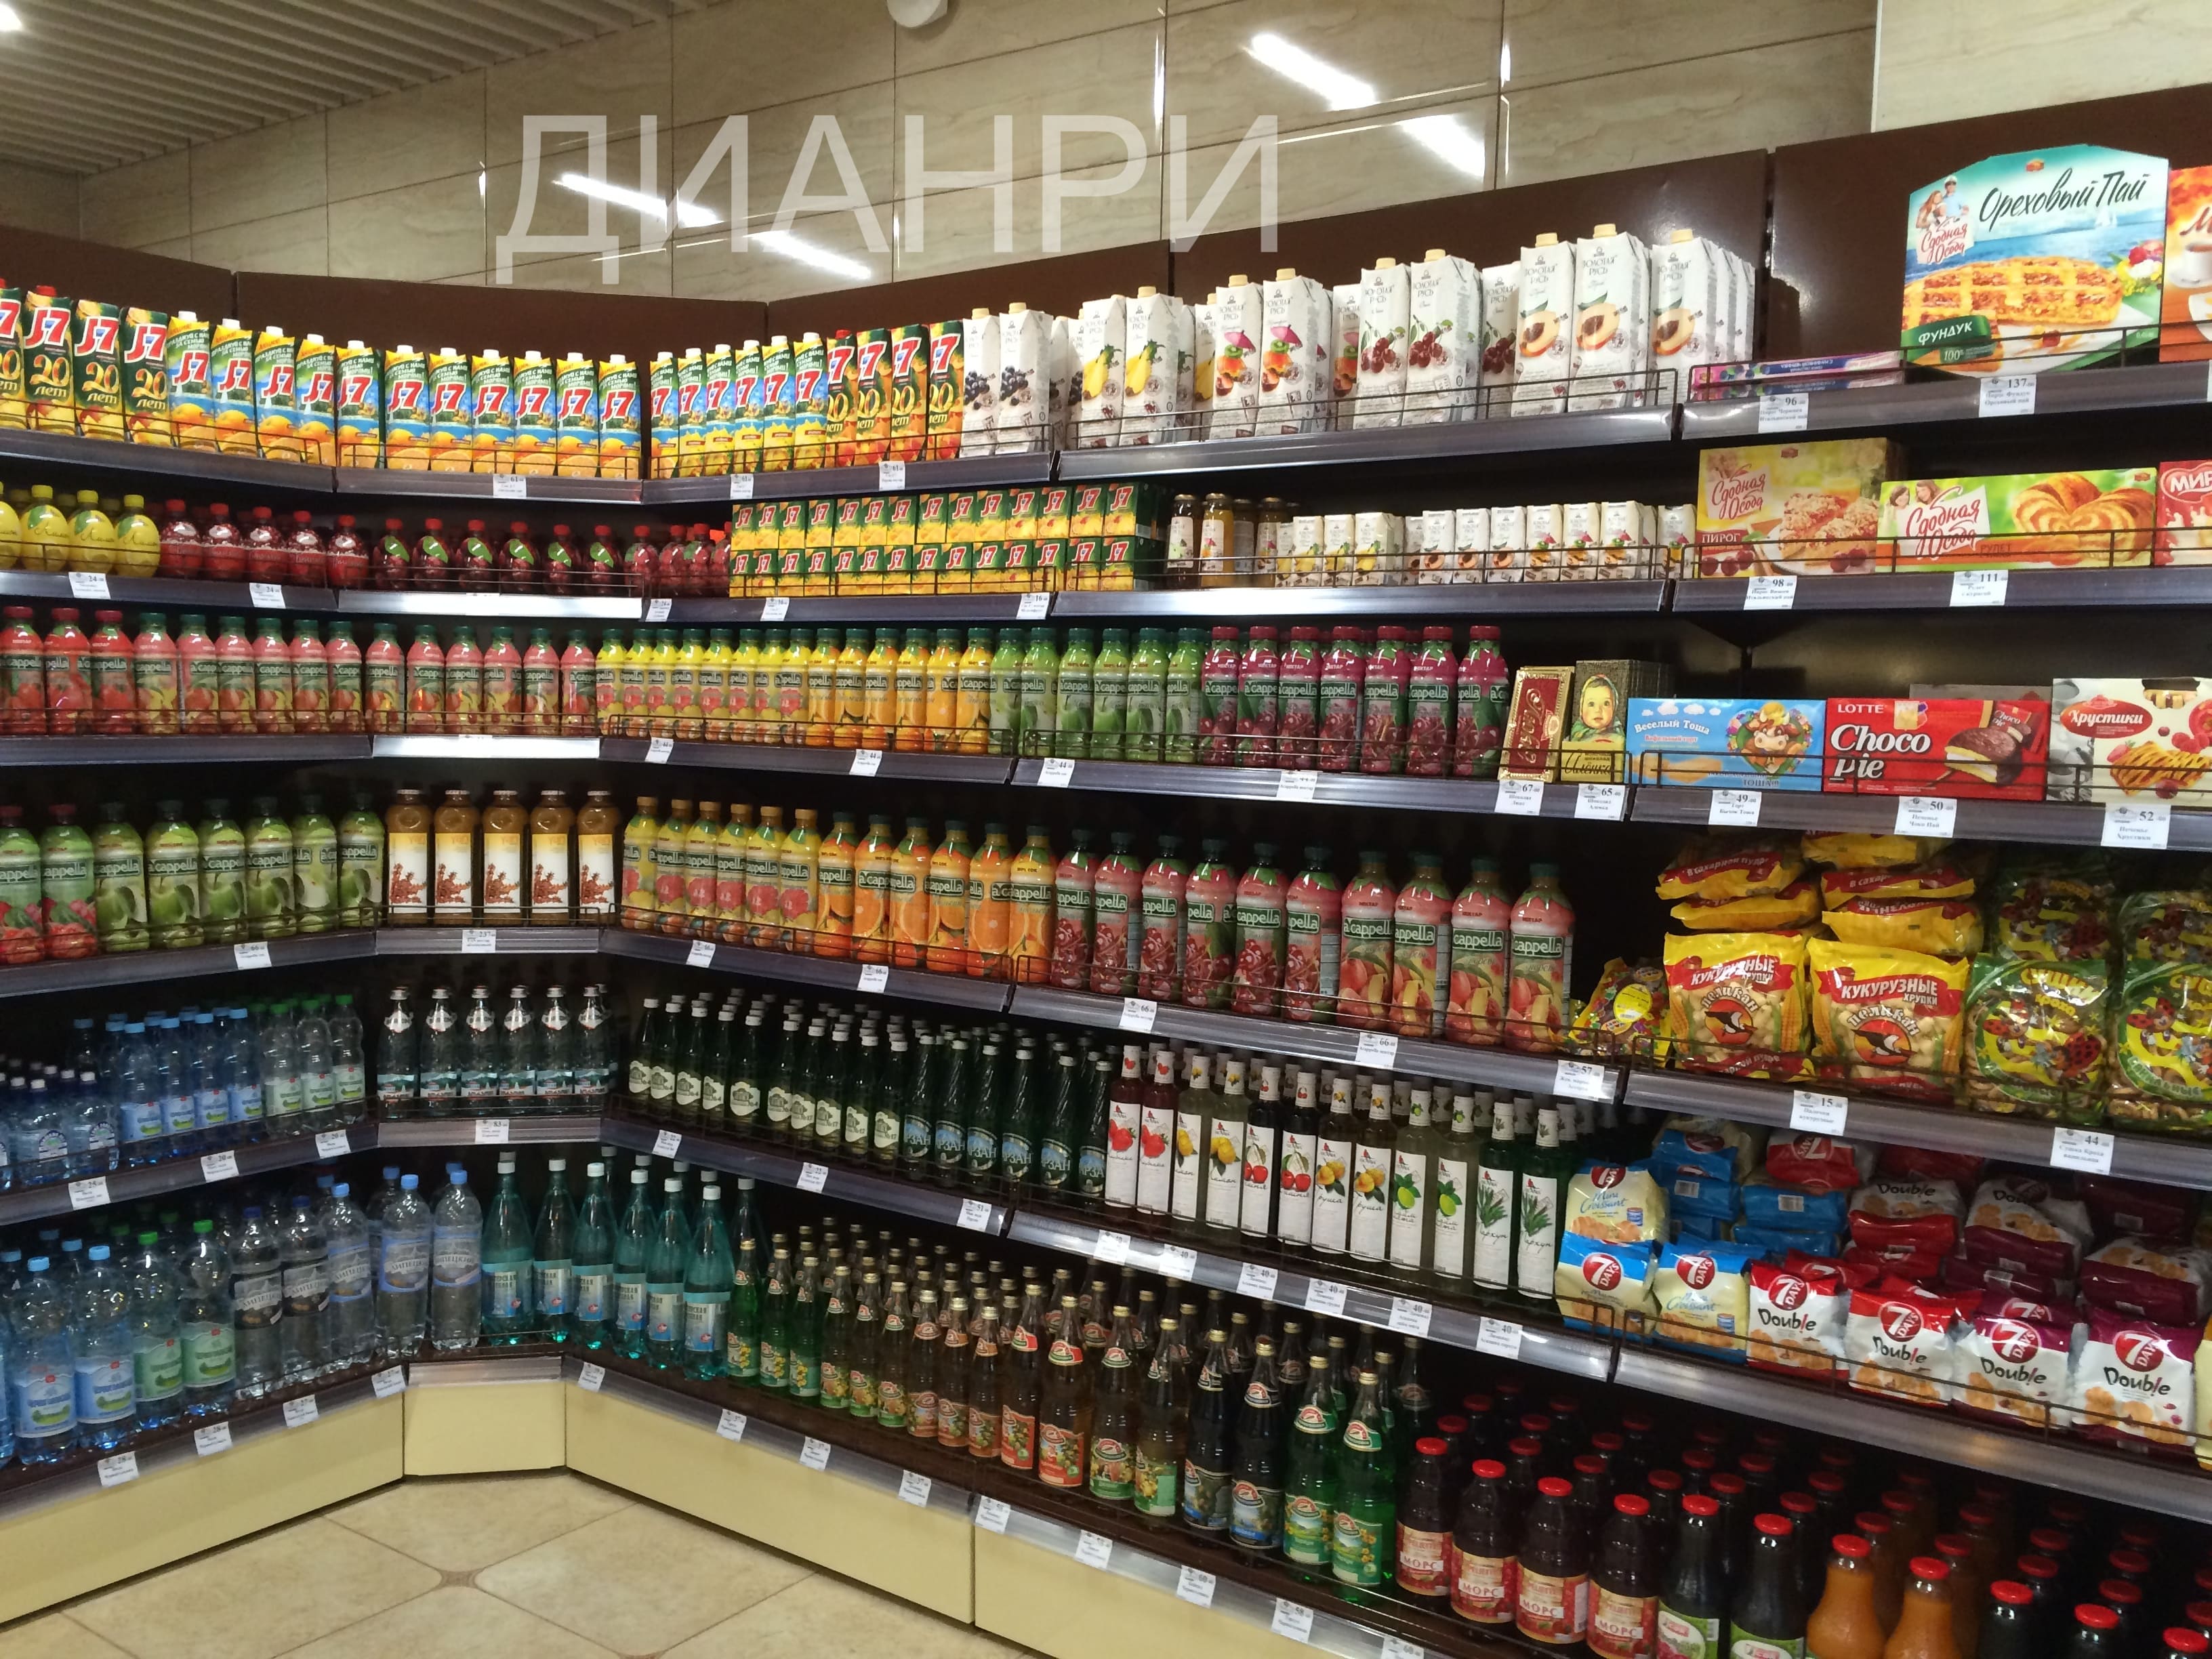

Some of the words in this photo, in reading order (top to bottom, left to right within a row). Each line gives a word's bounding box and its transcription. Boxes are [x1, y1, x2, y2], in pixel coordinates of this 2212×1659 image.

[1980, 168, 2098, 232] Ореховый
[2096, 171, 2150, 208] Пай
[1921, 218, 1968, 260] Сдобная
[1934, 237, 1967, 263] Особа
[1919, 321, 1973, 346] ФУНДУК
[30, 354, 68, 387] 20
[82, 362, 120, 393] 20
[131, 369, 167, 400] 20
[2008, 377, 2027, 388] 137
[33, 388, 67, 398] лет
[87, 392, 117, 405] лет
[1785, 397, 1797, 405] 96
[136, 400, 165, 410] лет
[1712, 464, 1765, 519] Сдобная
[1729, 493, 1763, 519] Особа
[1906, 486, 1980, 560] Сдобная
[1702, 533, 1740, 543] ПИРОГ
[1980, 544, 2011, 553] РУЛЕТ
[1772, 579, 1784, 587] 98
[1981, 573, 1998, 582] 111
[1837, 704, 1883, 714] LOTTE
[1634, 719, 1679, 733] Веселый
[1683, 720, 1709, 735] Тоша
[2068, 710, 2144, 727] Хрустики
[1830, 724, 1931, 753] Choco
[1829, 753, 1885, 781] pie
[1522, 784, 1533, 792] 67
[1601, 788, 1612, 796] 65
[1736, 794, 1748, 803] 49
[1929, 802, 1943, 811] 50
[2139, 811, 2154, 821] 52
[1237, 907, 1279, 928] cappella
[1454, 930, 1503, 950] cappella
[1513, 935, 1562, 957] cappella
[1841, 978, 1937, 1000] КУКУРУЗНЫЕ
[1903, 993, 1937, 1006] ХРУПКИ
[1379, 1038, 1389, 1046] 66
[1580, 1065, 1592, 1075] 57
[1821, 1097, 1833, 1107] 15
[2085, 1136, 2099, 1145] 44
[1591, 1256, 1614, 1286] 7
[1599, 1263, 1619, 1287] DAYS
[1687, 1256, 1707, 1285] 7
[1696, 1259, 1713, 1285] DAYS
[1775, 1279, 1796, 1306] 7
[1786, 1282, 1805, 1309] DAYS
[1412, 1305, 1422, 1313] 40
[1501, 1326, 1512, 1334] 40
[1887, 1306, 1912, 1336] 7
[1898, 1312, 1919, 1338] DAYS
[2000, 1323, 2027, 1357] 7
[2012, 1332, 2036, 1358] DAYS
[2125, 1334, 2153, 1365] 7
[2136, 1340, 2162, 1367] DAY
[1404, 1555, 1437, 1570] МОРС
[1463, 1582, 1498, 1597] МОРС
[1522, 1599, 1557, 1616] МОРС
[1599, 1619, 1637, 1637] МОРС
